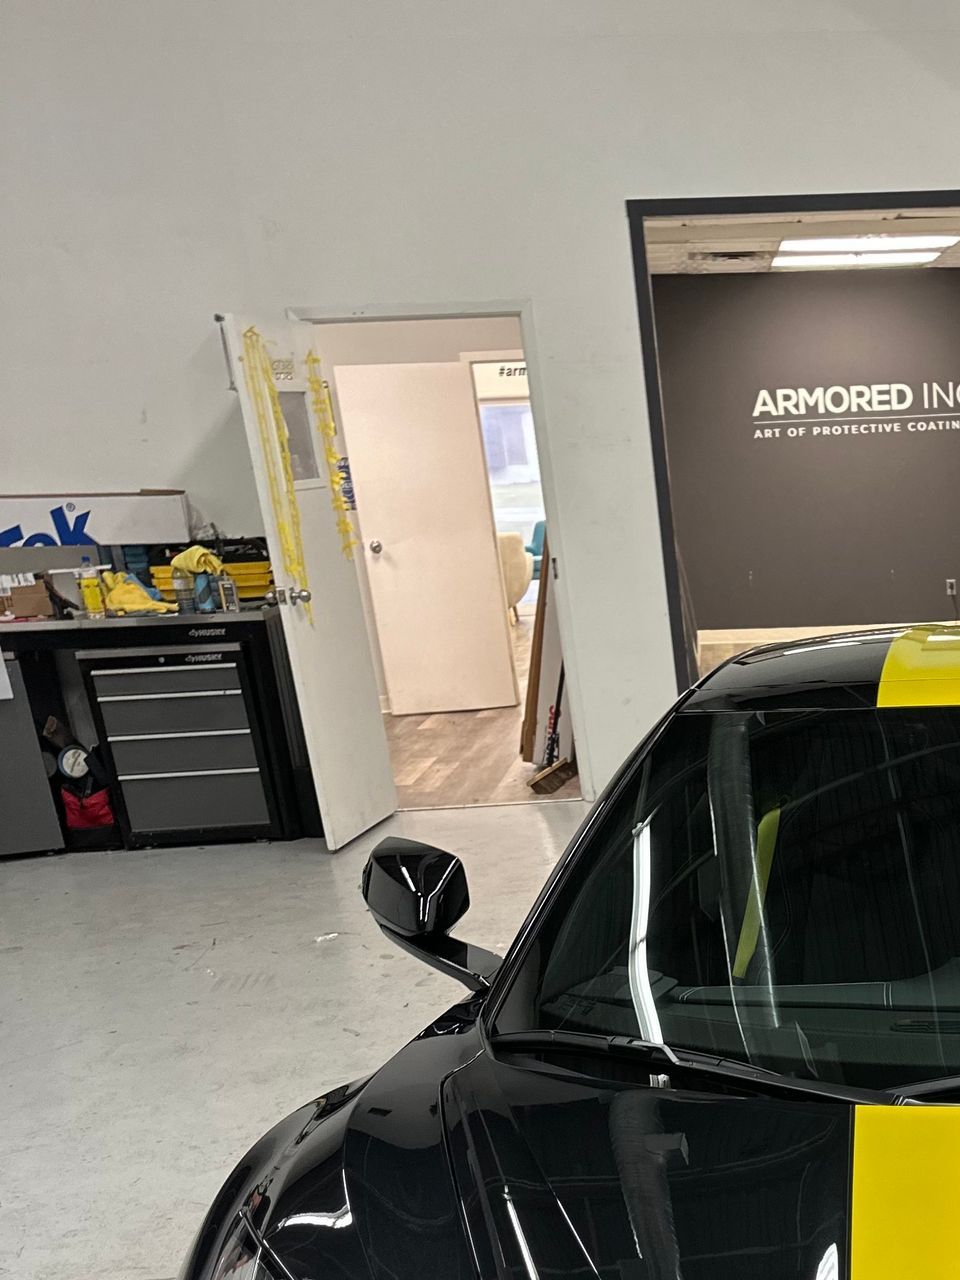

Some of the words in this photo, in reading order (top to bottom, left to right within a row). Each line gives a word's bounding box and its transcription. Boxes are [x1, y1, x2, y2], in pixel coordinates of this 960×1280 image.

[752, 384, 913, 417] ARMORED
[754, 428, 781, 439] ART
[787, 427, 806, 438] OF
[812, 423, 901, 436] PROTECTIVE
